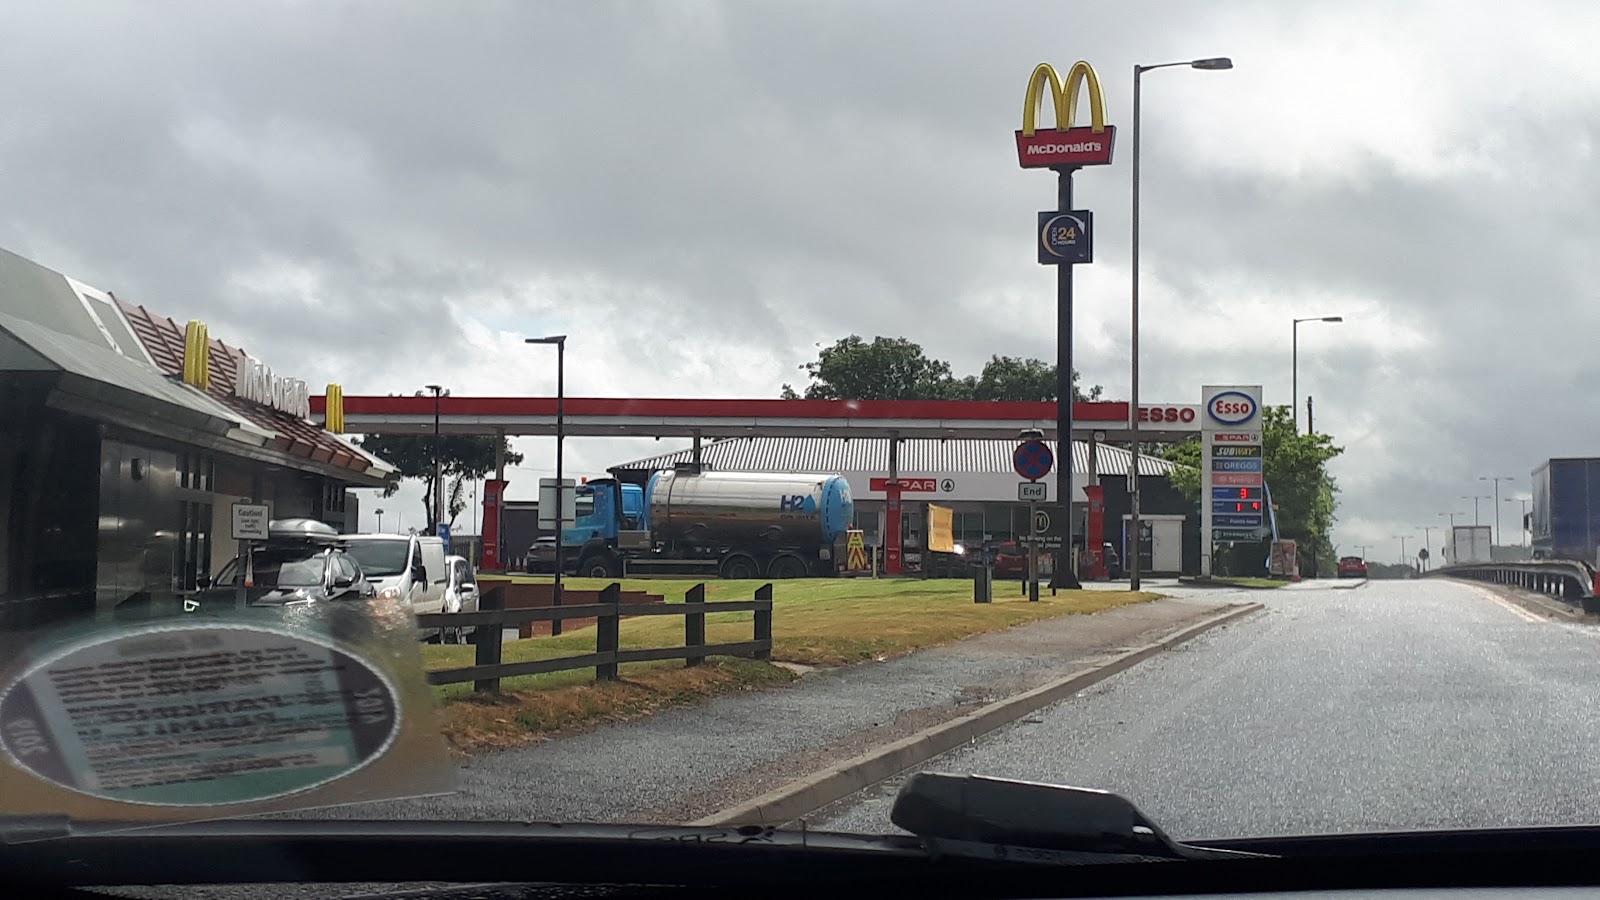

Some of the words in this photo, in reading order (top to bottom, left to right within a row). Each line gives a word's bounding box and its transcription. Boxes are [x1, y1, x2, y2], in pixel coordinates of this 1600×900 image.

[1026, 140, 1102, 155] McDonald's
[1057, 227, 1076, 240] 24
[1215, 400, 1249, 414] Esso
[1138, 407, 1195, 423] ESSO
[1216, 447, 1254, 456] SUBWAY
[1224, 461, 1257, 469] GREGGS
[885, 480, 935, 490] PAR
[1023, 487, 1042, 497] End
